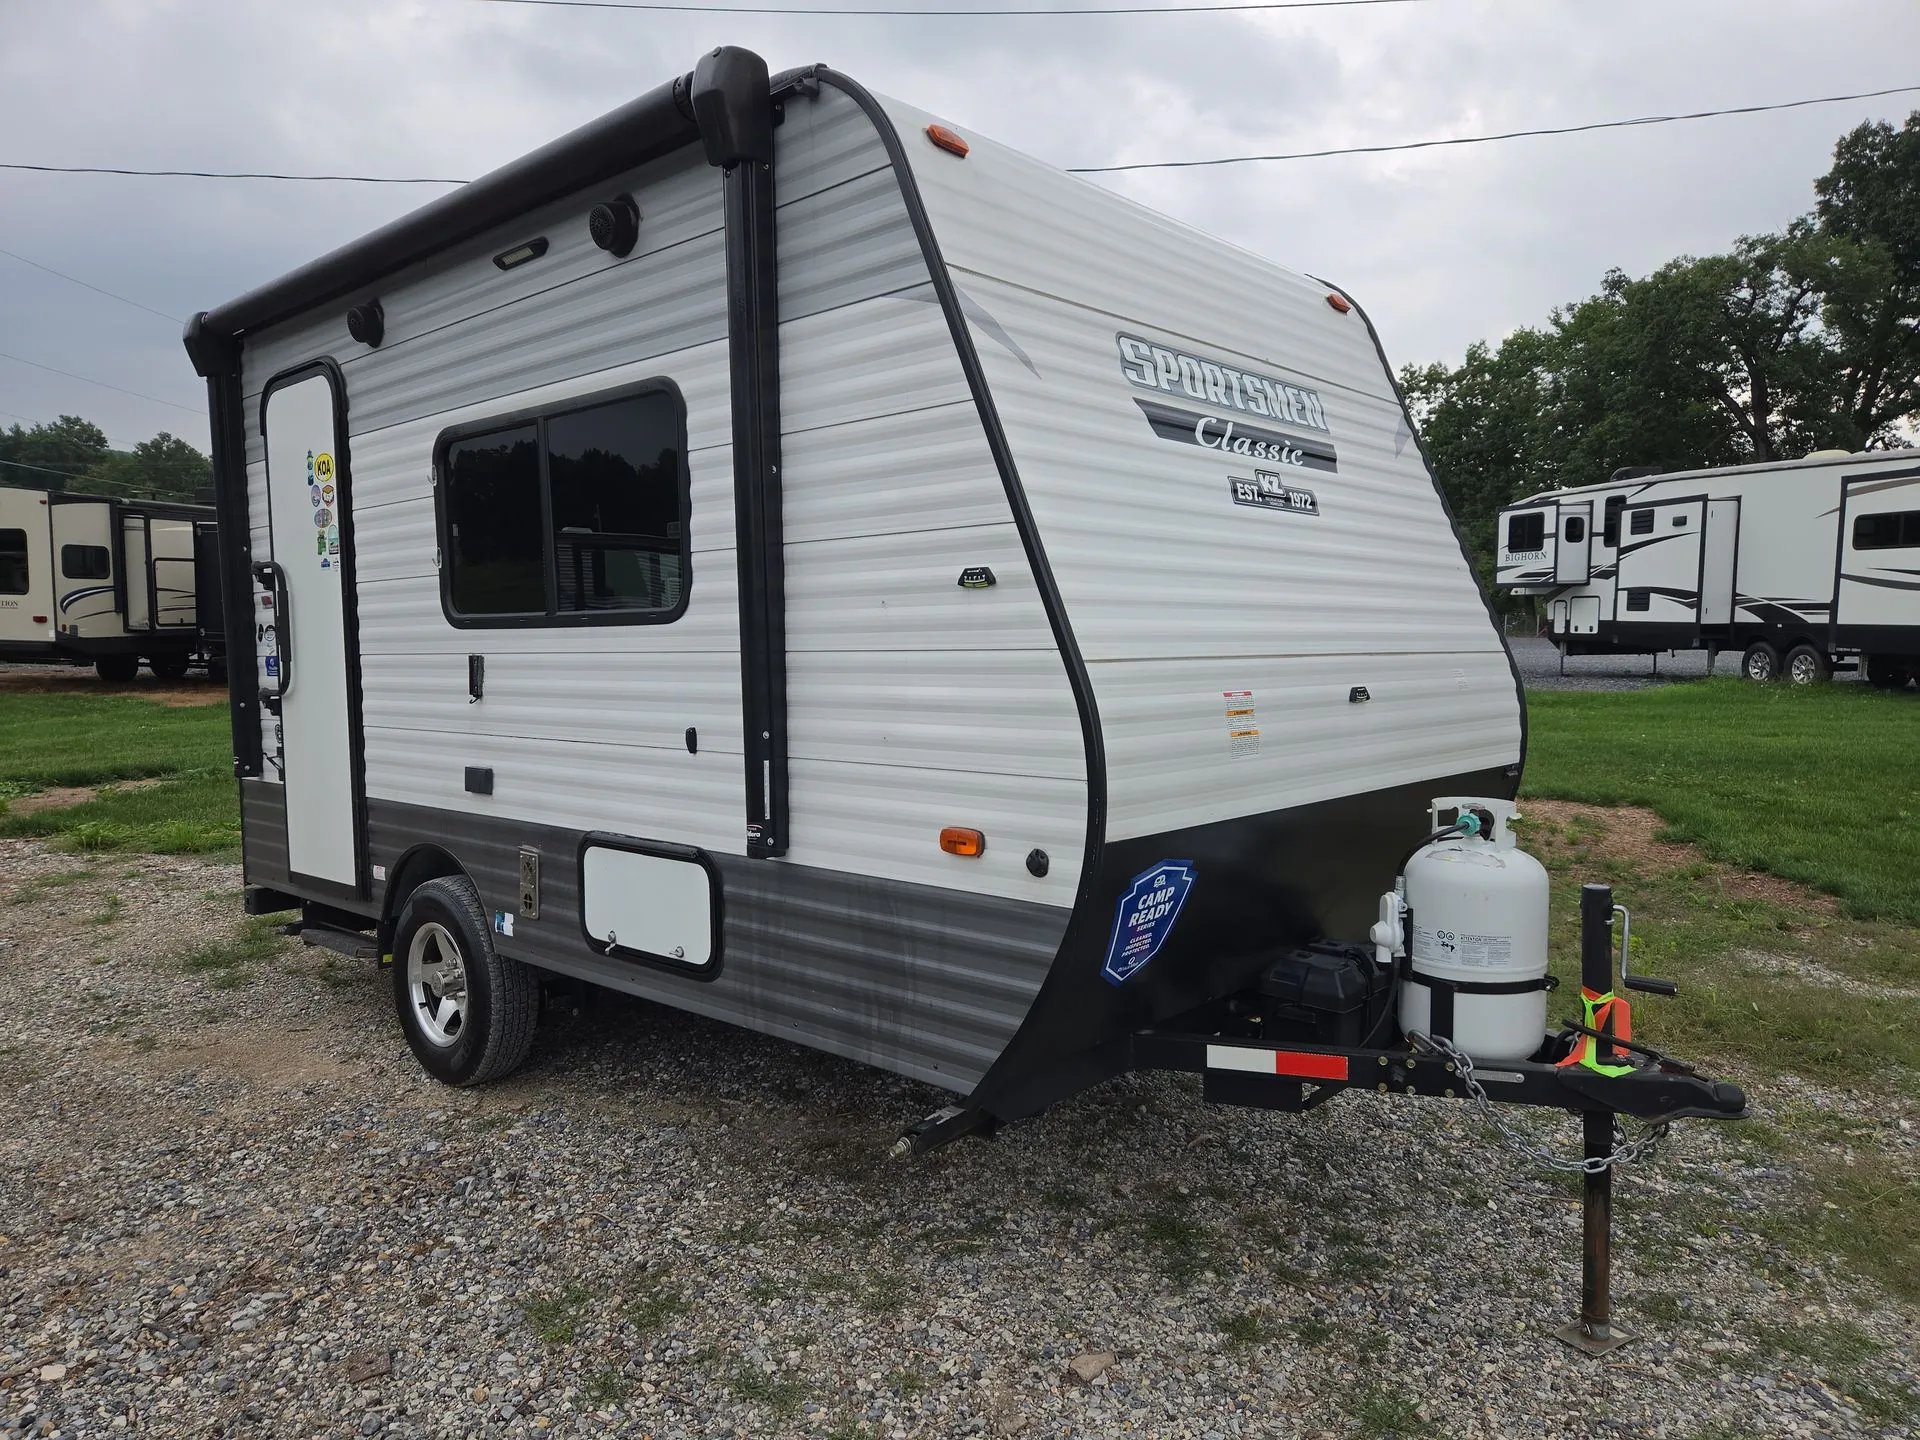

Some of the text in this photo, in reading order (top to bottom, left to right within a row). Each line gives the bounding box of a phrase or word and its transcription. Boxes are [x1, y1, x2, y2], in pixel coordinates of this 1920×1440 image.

[1118, 334, 1329, 431] SPORTSMEN
[1194, 417, 1304, 466] Classic
[317, 459, 331, 476] KOA
[1258, 473, 1285, 494] KZ
[1236, 482, 1263, 502] EST.
[1289, 491, 1313, 510] 1972
[1505, 551, 1547, 561] BIGHORN
[1138, 887, 1175, 910] CAMP
[1128, 900, 1174, 928] READY
[1136, 920, 1156, 932] SERIES
